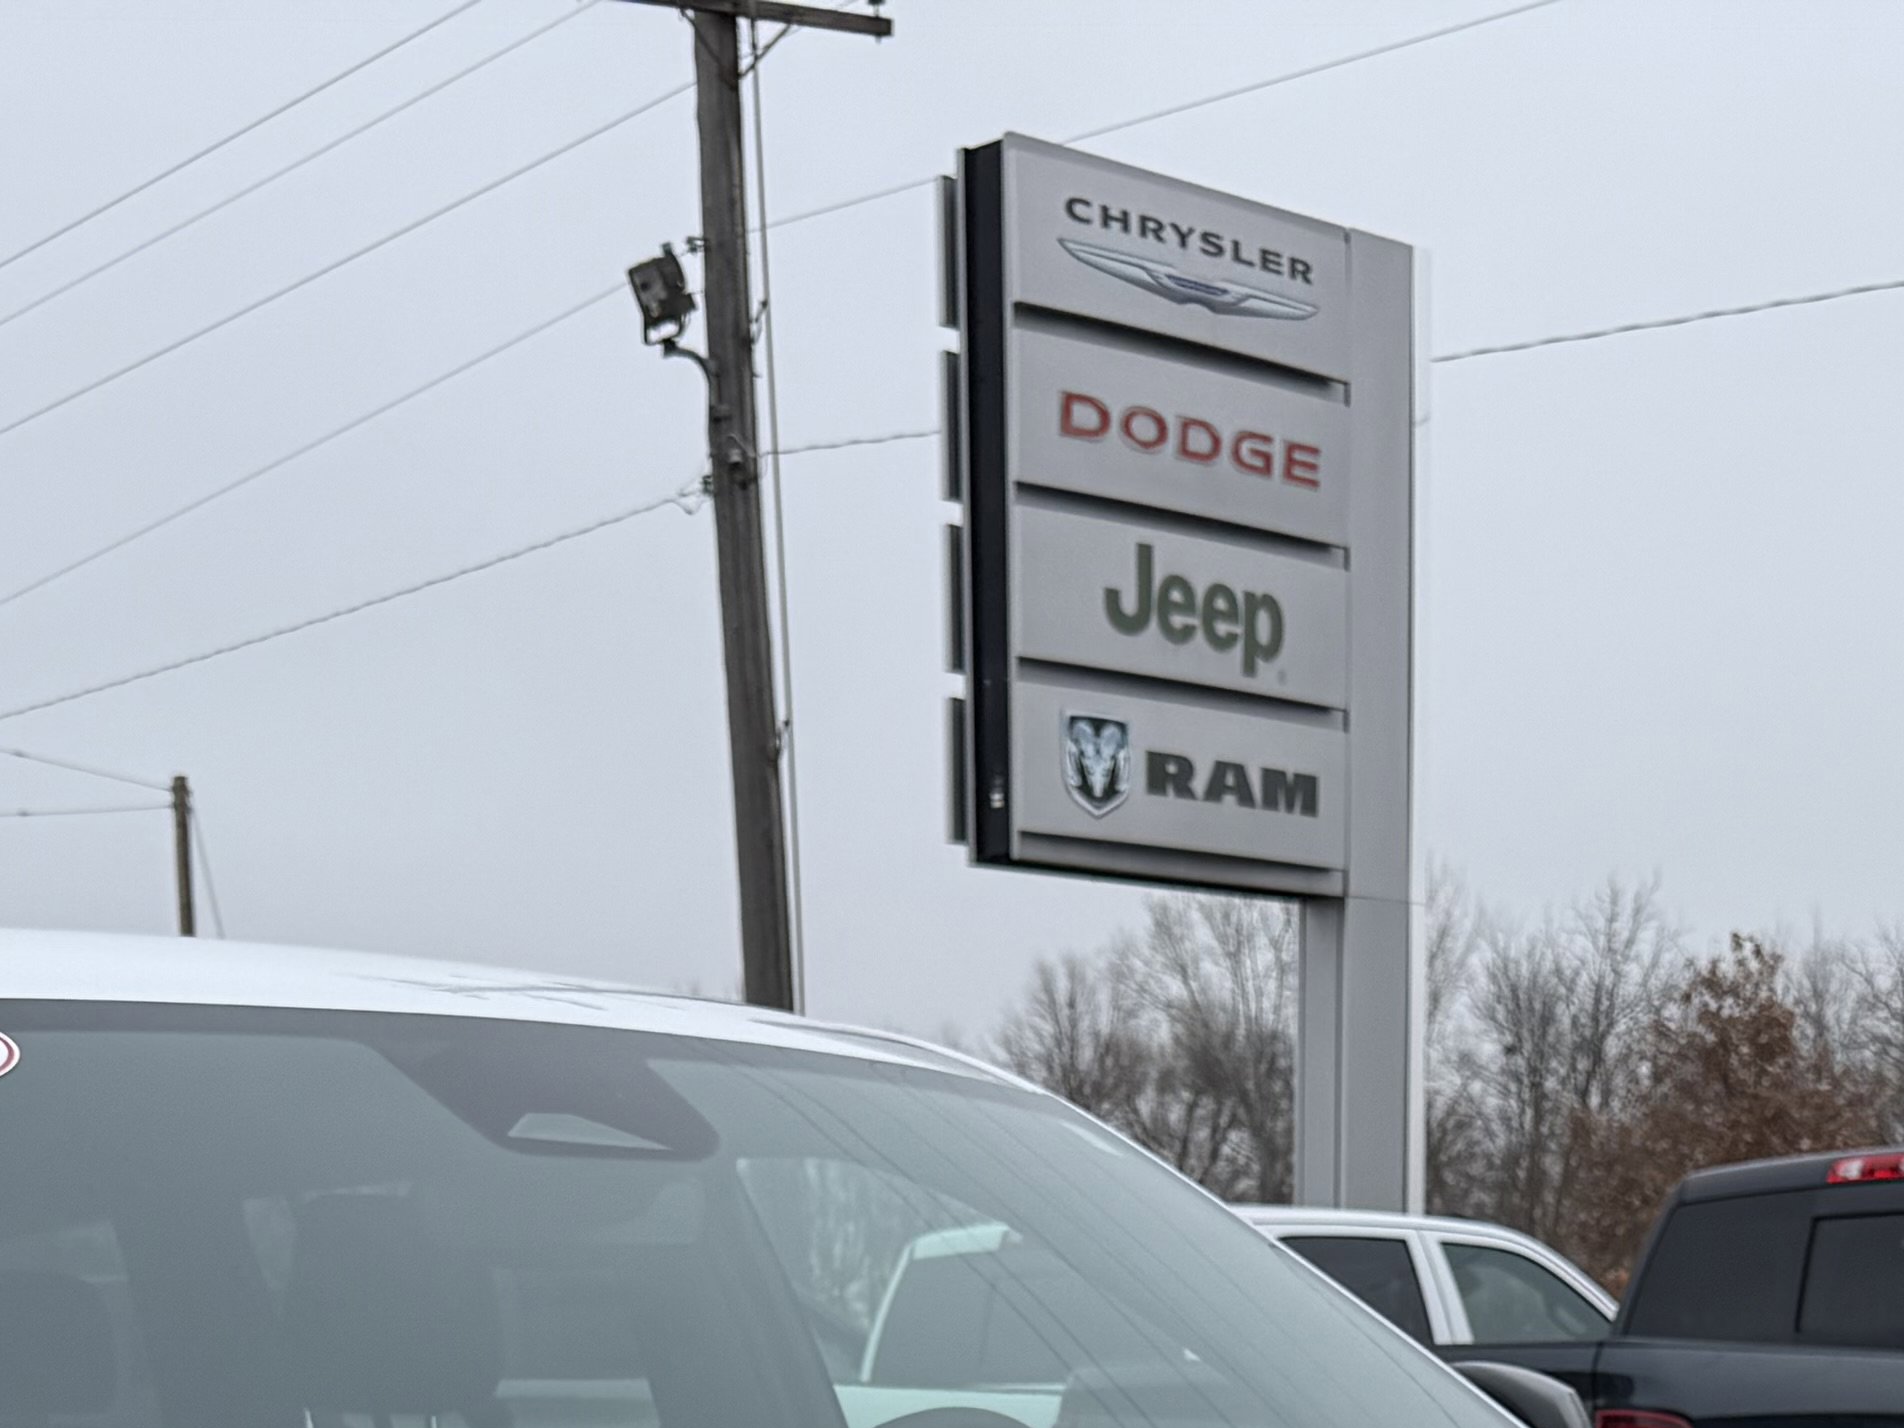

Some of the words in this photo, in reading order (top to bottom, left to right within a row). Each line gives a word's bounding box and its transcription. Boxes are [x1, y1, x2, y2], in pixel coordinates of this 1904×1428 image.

[1063, 197, 1314, 286] CHRYSLER
[1060, 390, 1321, 490] DODGE
[1104, 543, 1284, 676] Jeep
[1145, 750, 1319, 818] RAM
